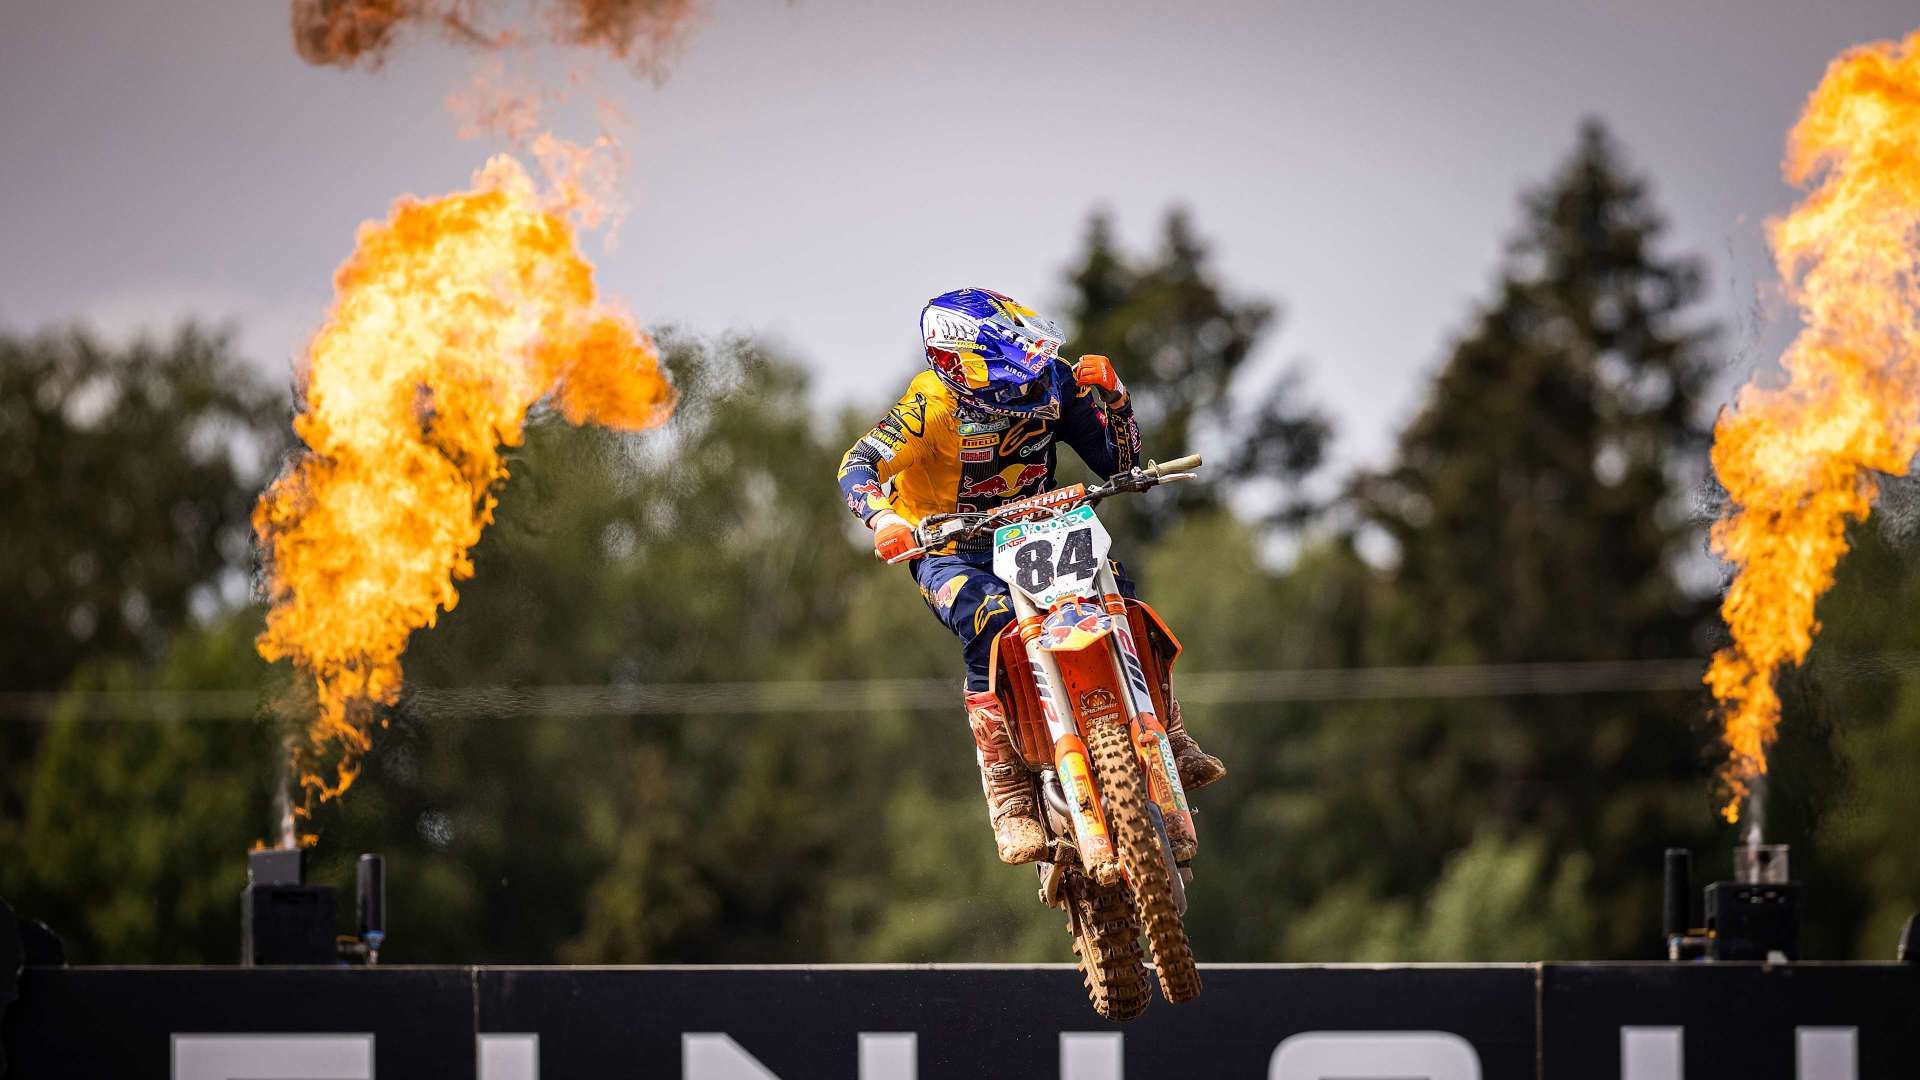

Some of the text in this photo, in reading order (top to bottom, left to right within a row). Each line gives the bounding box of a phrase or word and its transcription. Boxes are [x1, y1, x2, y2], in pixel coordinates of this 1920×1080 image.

[1031, 339, 1061, 373] Red Bull
[1003, 364, 1028, 380] AIROH
[961, 434, 998, 447] PIRELLI
[1014, 527, 1099, 595] 84
